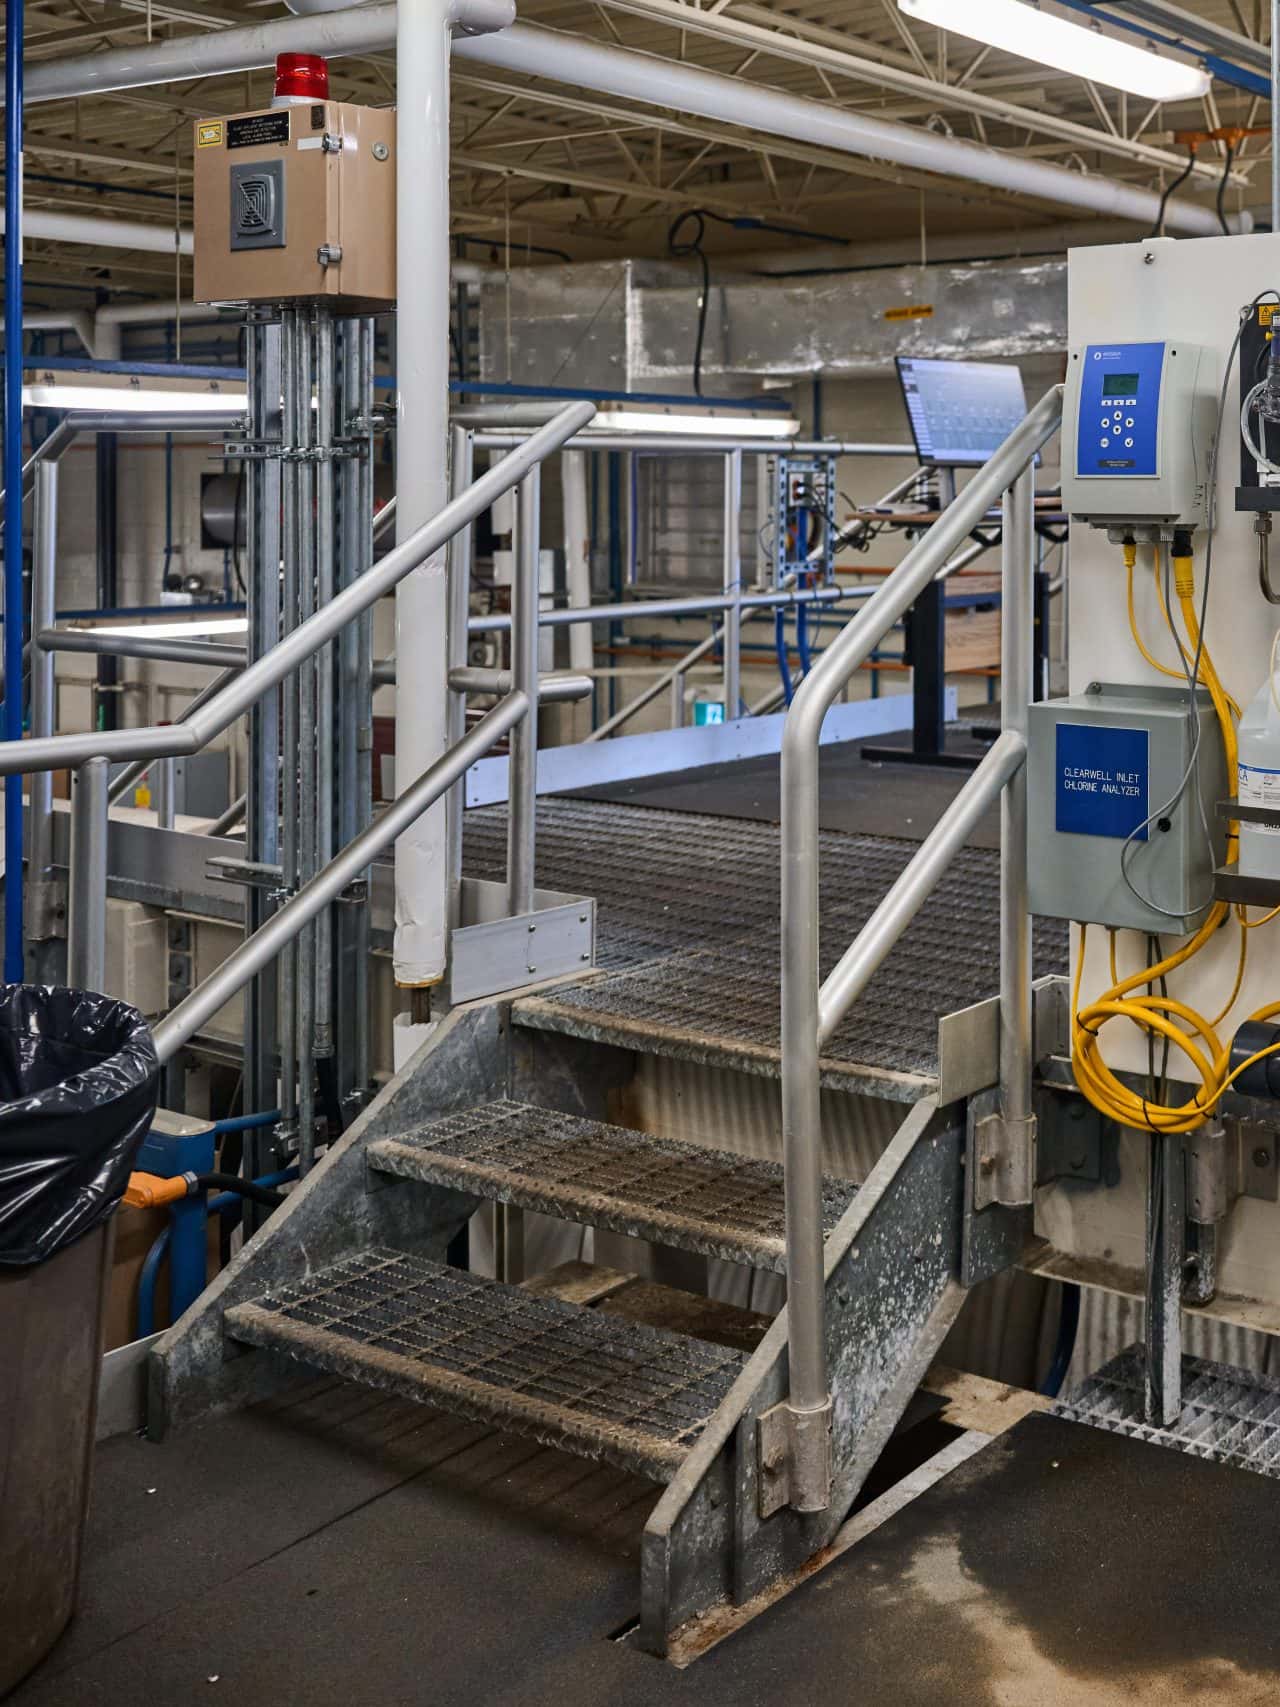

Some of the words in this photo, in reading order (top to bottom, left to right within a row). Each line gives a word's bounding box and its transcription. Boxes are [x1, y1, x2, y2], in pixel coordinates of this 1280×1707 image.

[1064, 767, 1112, 781] CLEARWELL
[1116, 772, 1140, 783] INLET
[1064, 780, 1097, 792] CHLORINE
[1101, 783, 1140, 796] ANALYZER
